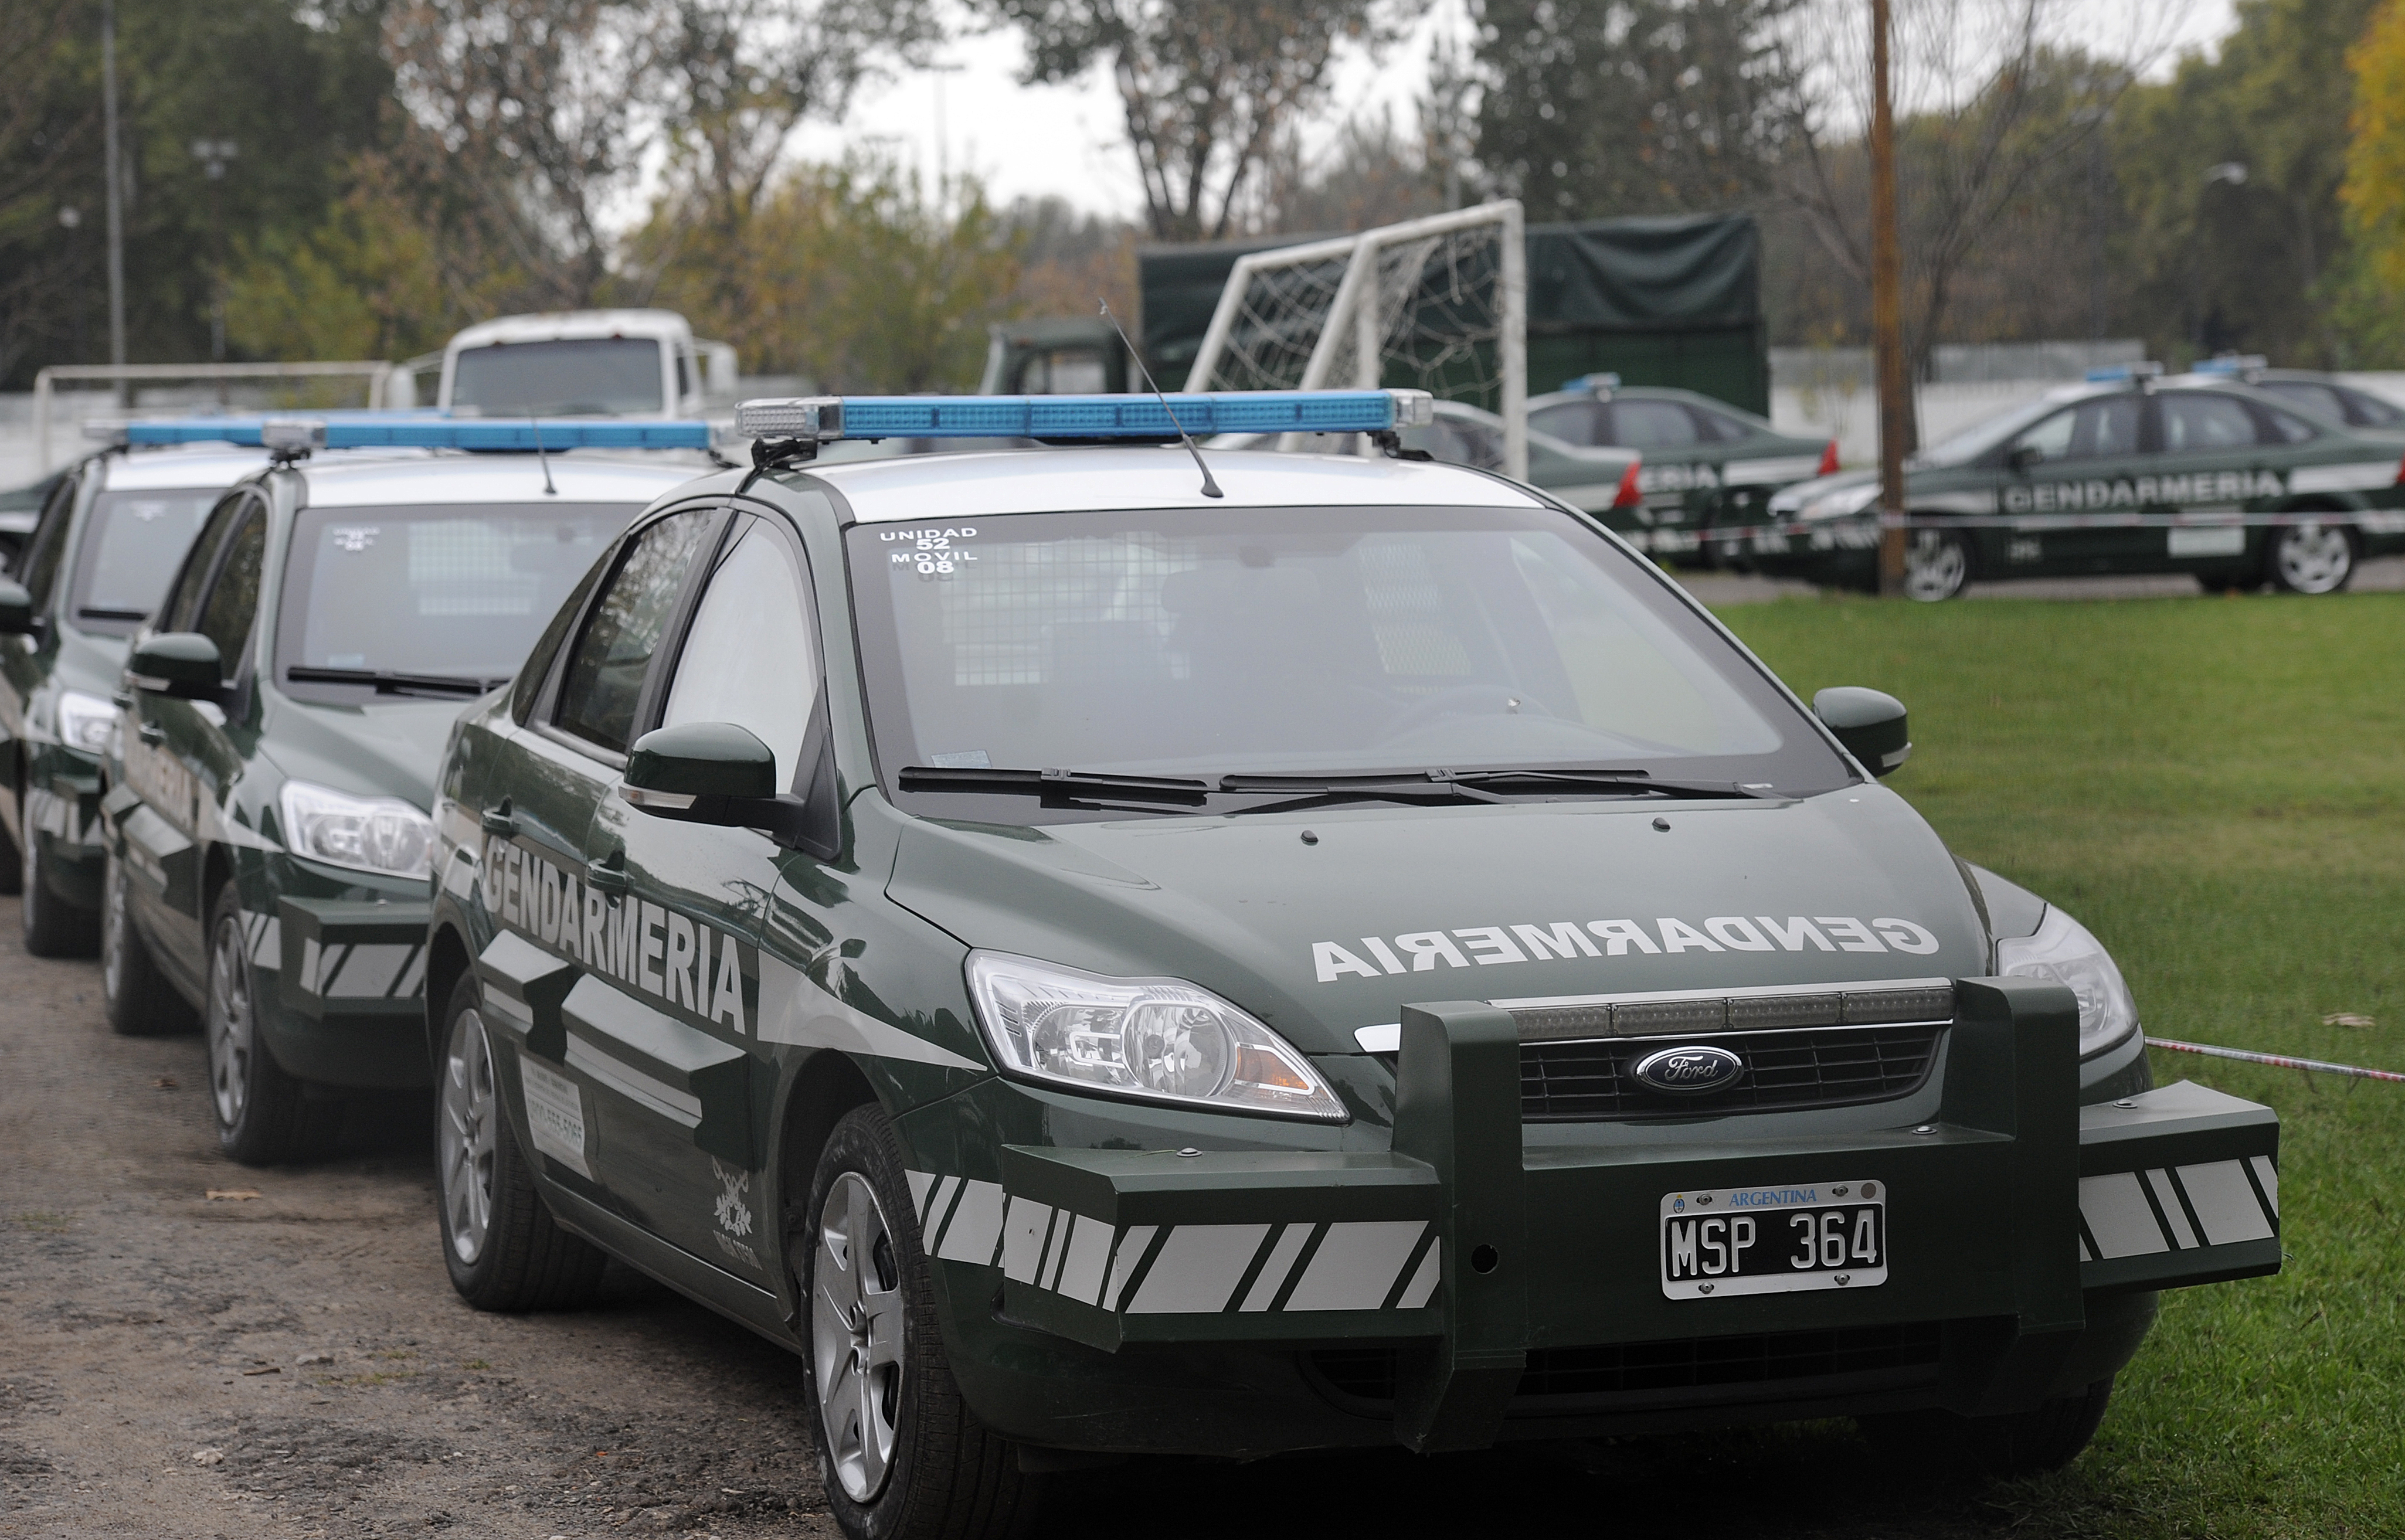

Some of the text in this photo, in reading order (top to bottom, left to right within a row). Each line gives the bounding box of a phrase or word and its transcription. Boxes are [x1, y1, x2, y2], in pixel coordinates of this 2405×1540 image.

[2004, 469, 2284, 514] GENDARMERIA
[880, 528, 977, 541] UNIDAD
[916, 538, 950, 550] 52
[892, 551, 978, 563] MOVIL
[917, 560, 954, 574] 08
[483, 834, 746, 1036] GENDARMERIA
[1665, 1055, 1718, 1081] Ford
[1729, 1189, 1818, 1206] ARGENTINA
[1672, 1209, 1877, 1277] MSP 364
